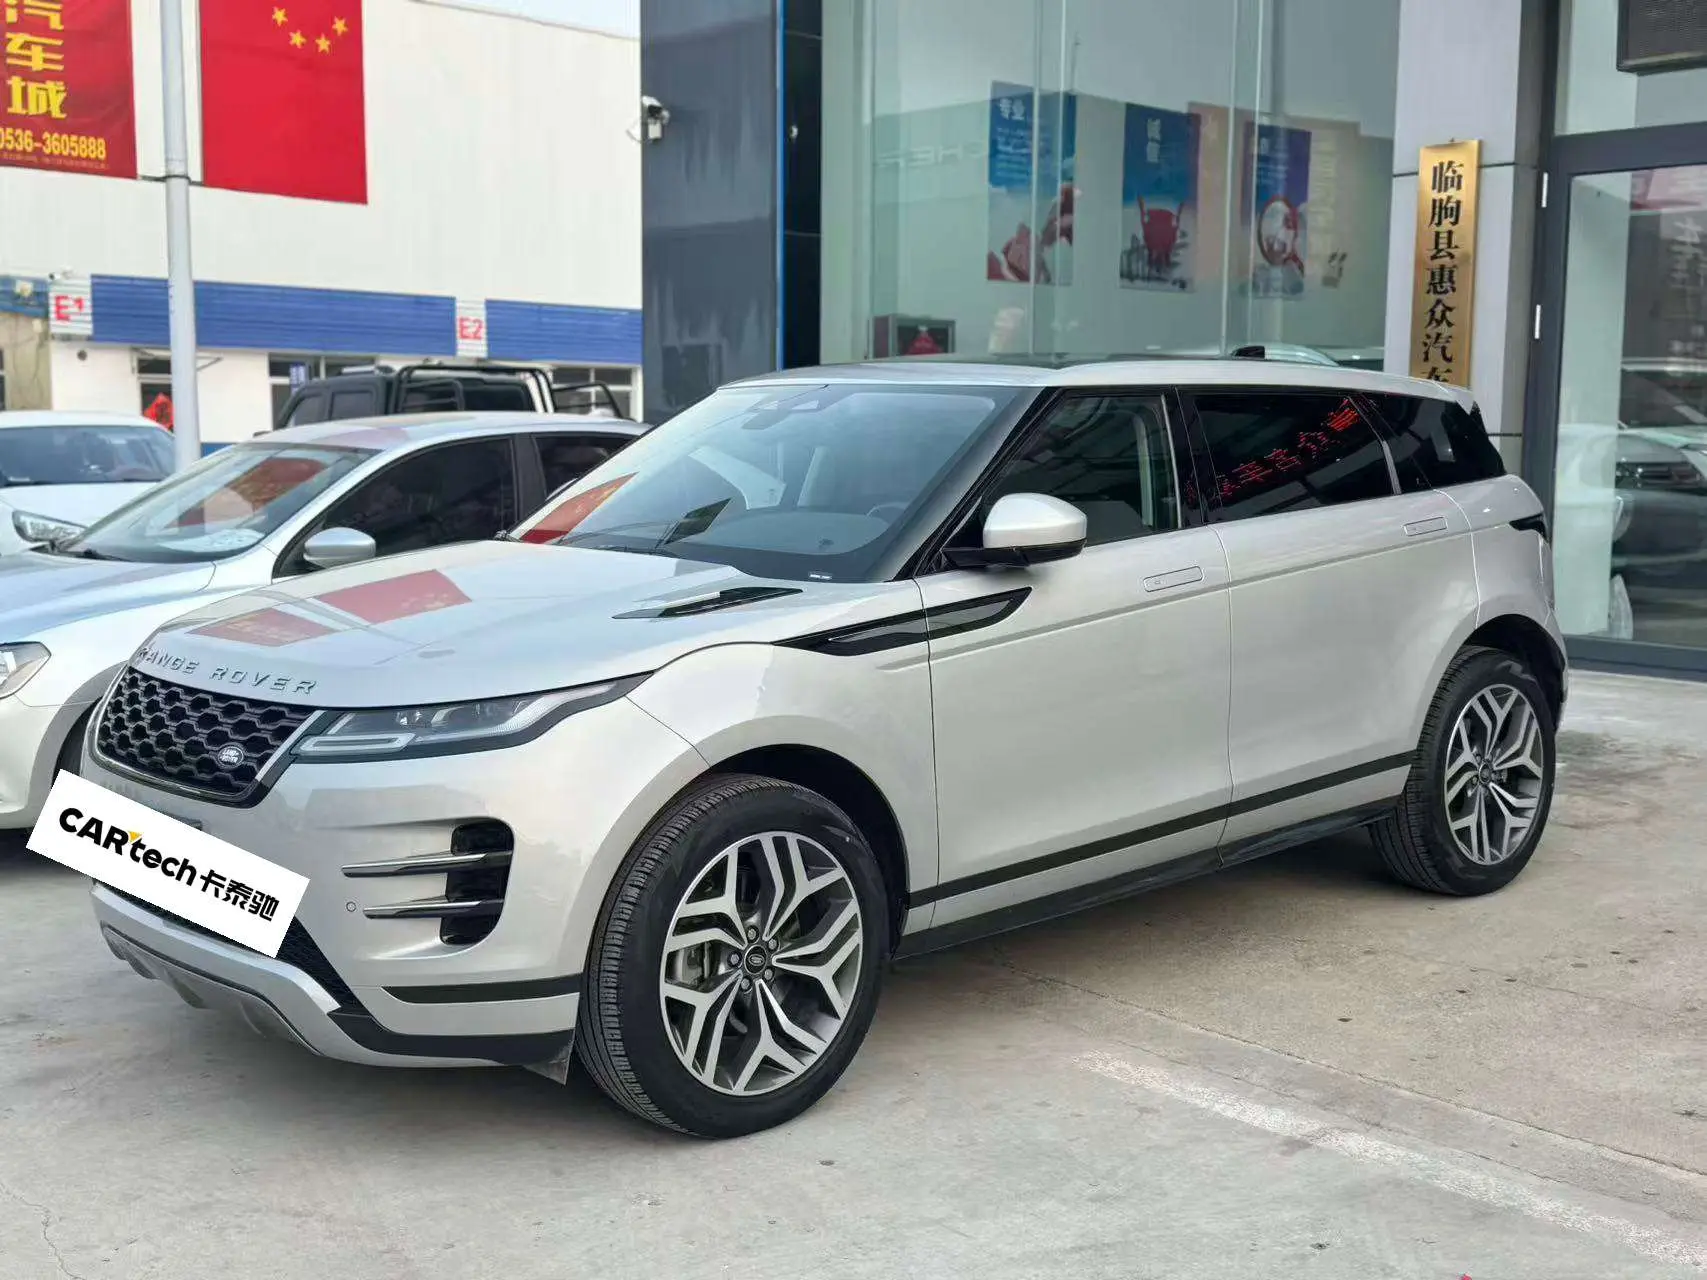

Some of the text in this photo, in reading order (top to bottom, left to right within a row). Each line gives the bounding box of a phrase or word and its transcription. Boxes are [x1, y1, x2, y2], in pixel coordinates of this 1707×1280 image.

[4, 0, 68, 119] 汽车城
[459, 316, 484, 341] E2
[209, 665, 318, 695] ROVER
